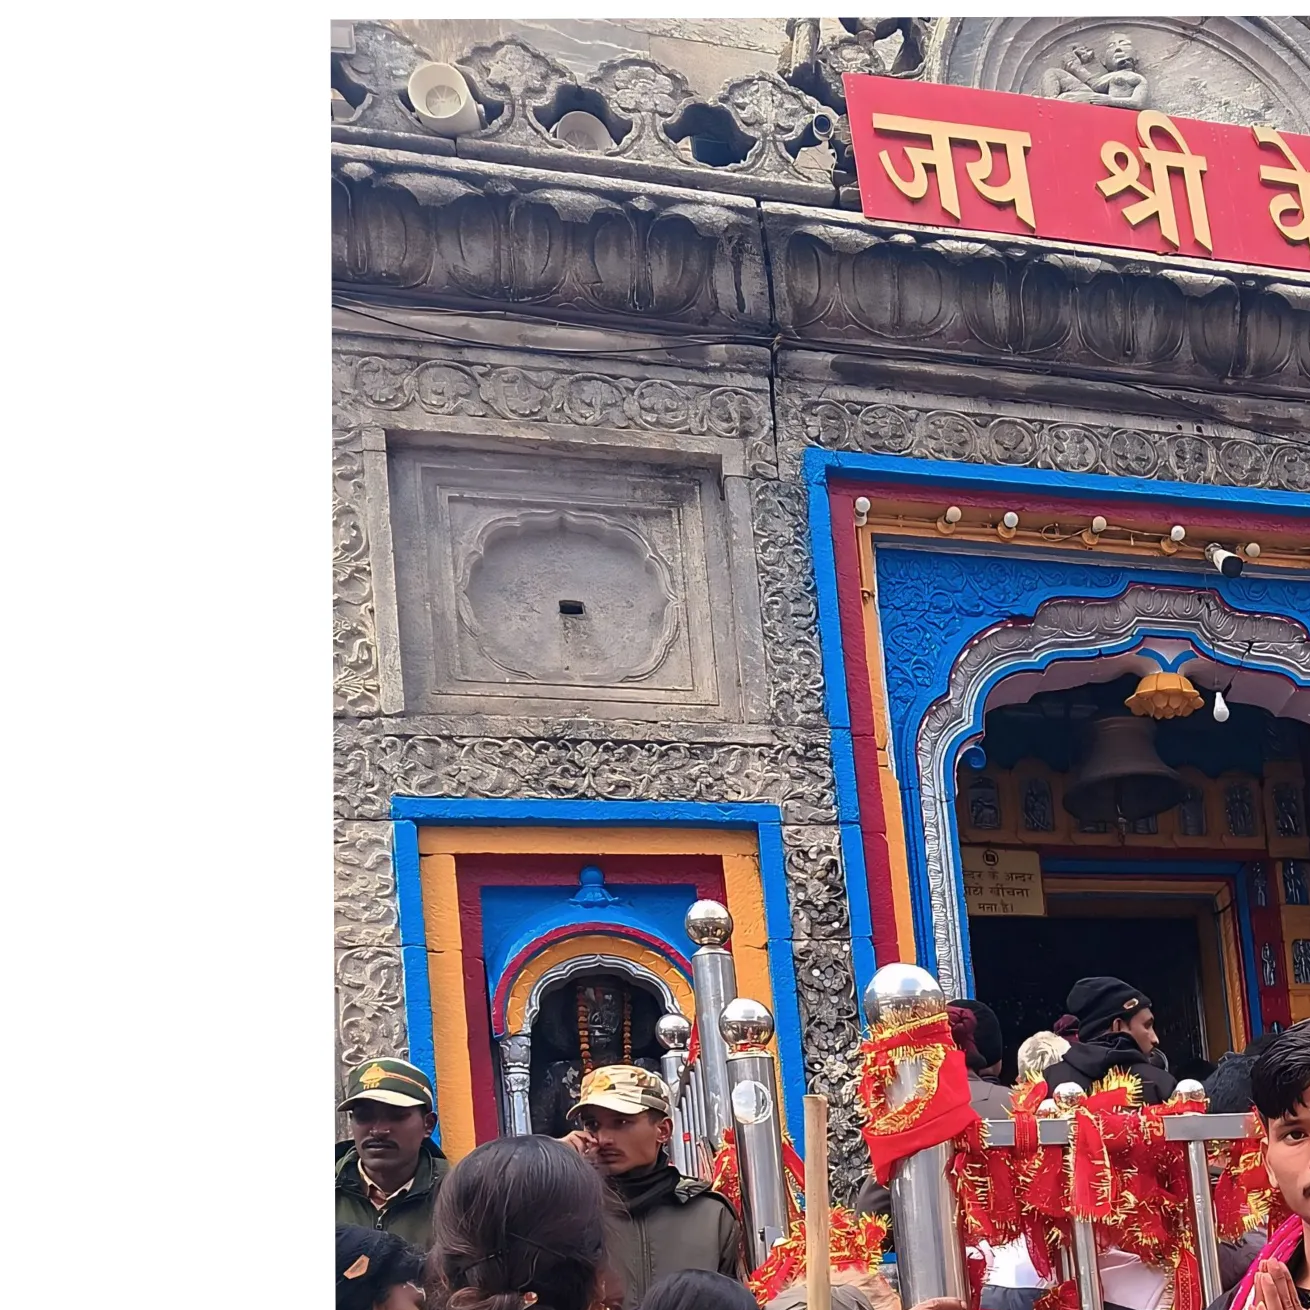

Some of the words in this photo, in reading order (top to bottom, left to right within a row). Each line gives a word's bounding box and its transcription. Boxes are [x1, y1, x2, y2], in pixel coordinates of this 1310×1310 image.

[873, 112, 1036, 230] जय
[1095, 110, 1213, 255] श्री
[978, 903, 997, 912] मना
